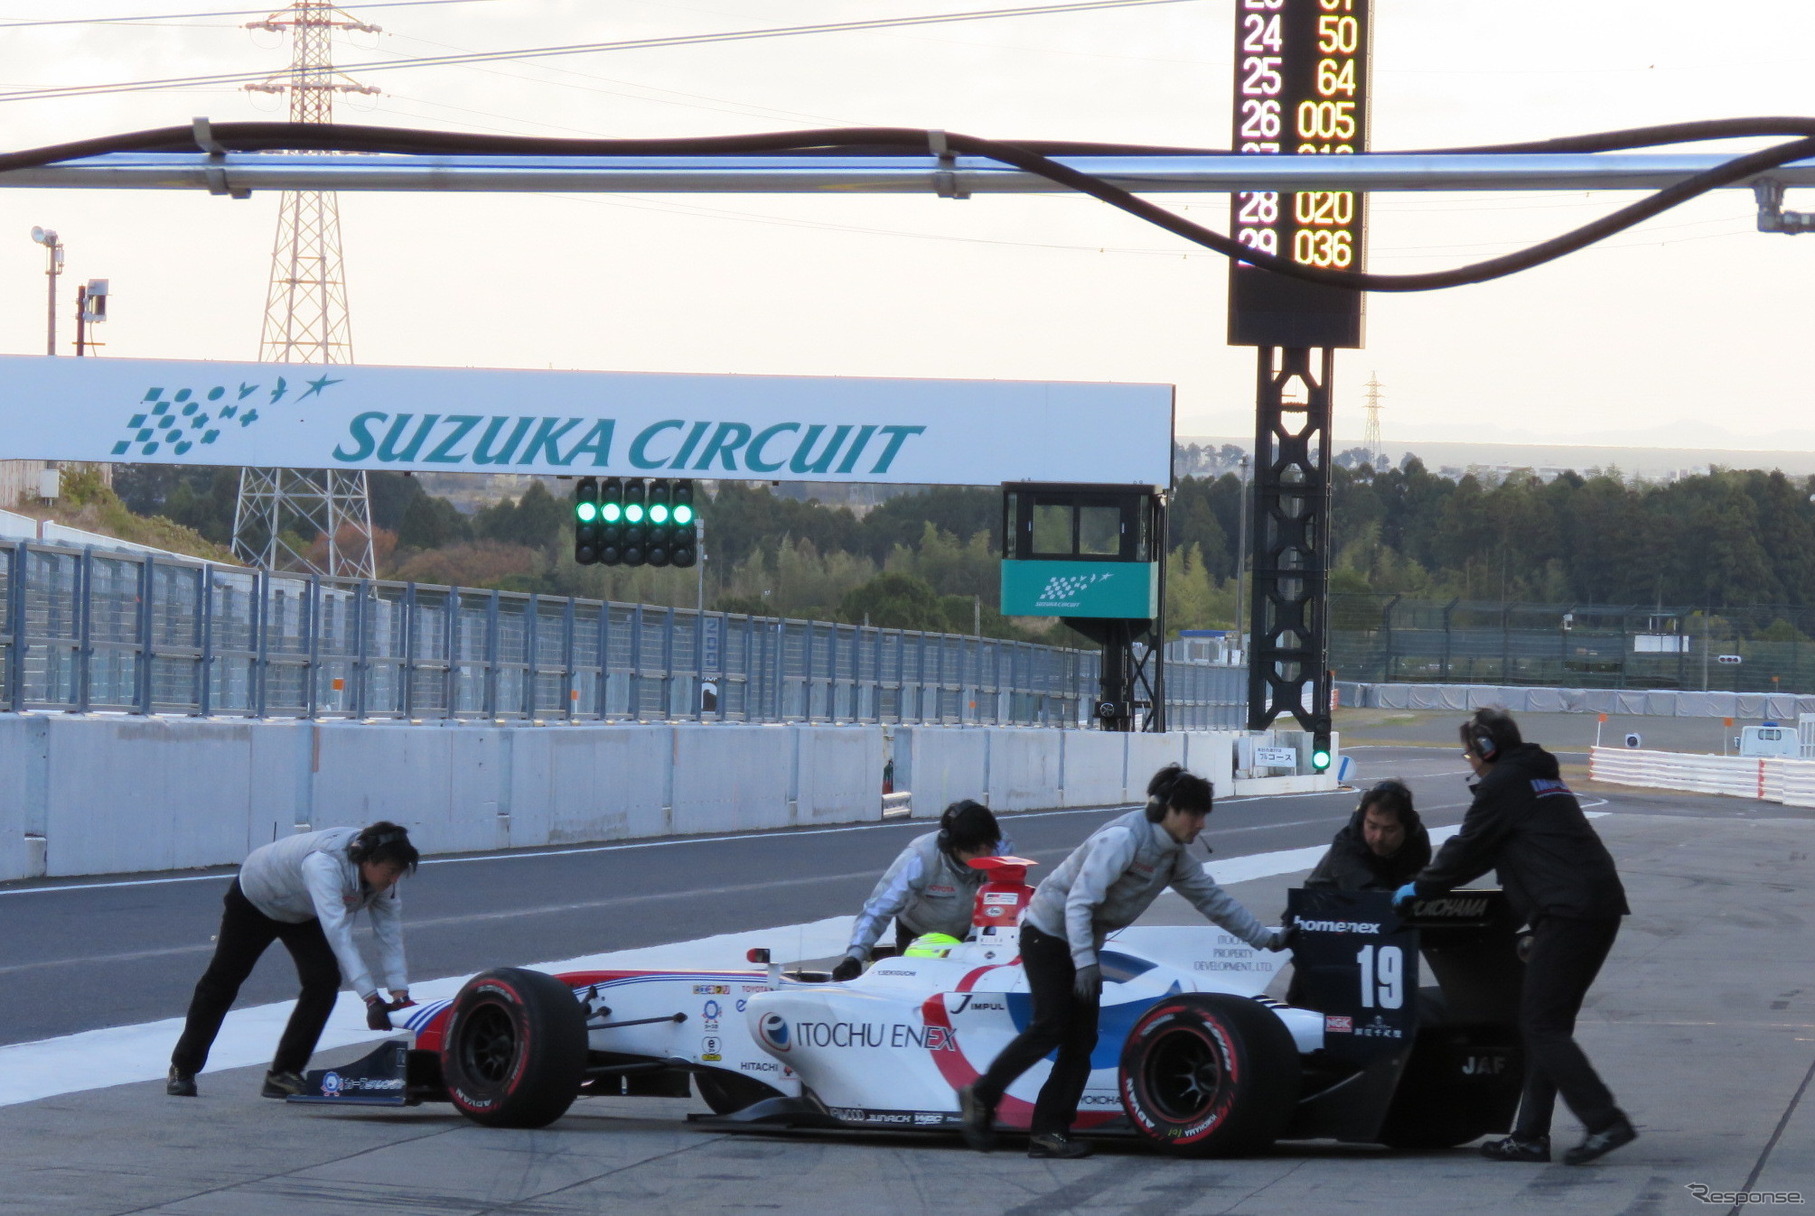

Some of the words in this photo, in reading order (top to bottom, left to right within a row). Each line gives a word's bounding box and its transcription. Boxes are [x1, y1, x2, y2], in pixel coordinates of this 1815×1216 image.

[1243, 14, 1282, 52] 24
[1318, 16, 1357, 53] 50
[1242, 57, 1282, 94] 25
[1317, 58, 1356, 96] 64
[1241, 100, 1281, 137] 26
[1298, 101, 1355, 139] 005
[1239, 191, 1278, 223] 28
[1296, 191, 1353, 224] 020
[1294, 229, 1352, 267] 036
[332, 411, 615, 465] SUZUKA
[628, 419, 927, 474] CIRCUIT
[1411, 899, 1488, 917] OKOHAMA
[1213, 948, 1253, 958] PROPERTY
[1357, 944, 1403, 1009] 19
[742, 985, 768, 993] TOYOTA
[970, 1003, 1006, 1011] IMPUL
[1326, 1018, 1350, 1027] NGK
[797, 1022, 885, 1048] ITOCHU
[891, 1024, 957, 1052] ENEX
[741, 1063, 779, 1072] HITACHI
[1462, 1056, 1505, 1075] JAF
[456, 1087, 492, 1108] ADVAN
[1081, 1095, 1121, 1105] YOKOHA
[1185, 1113, 1218, 1137] YOKOHAMA
